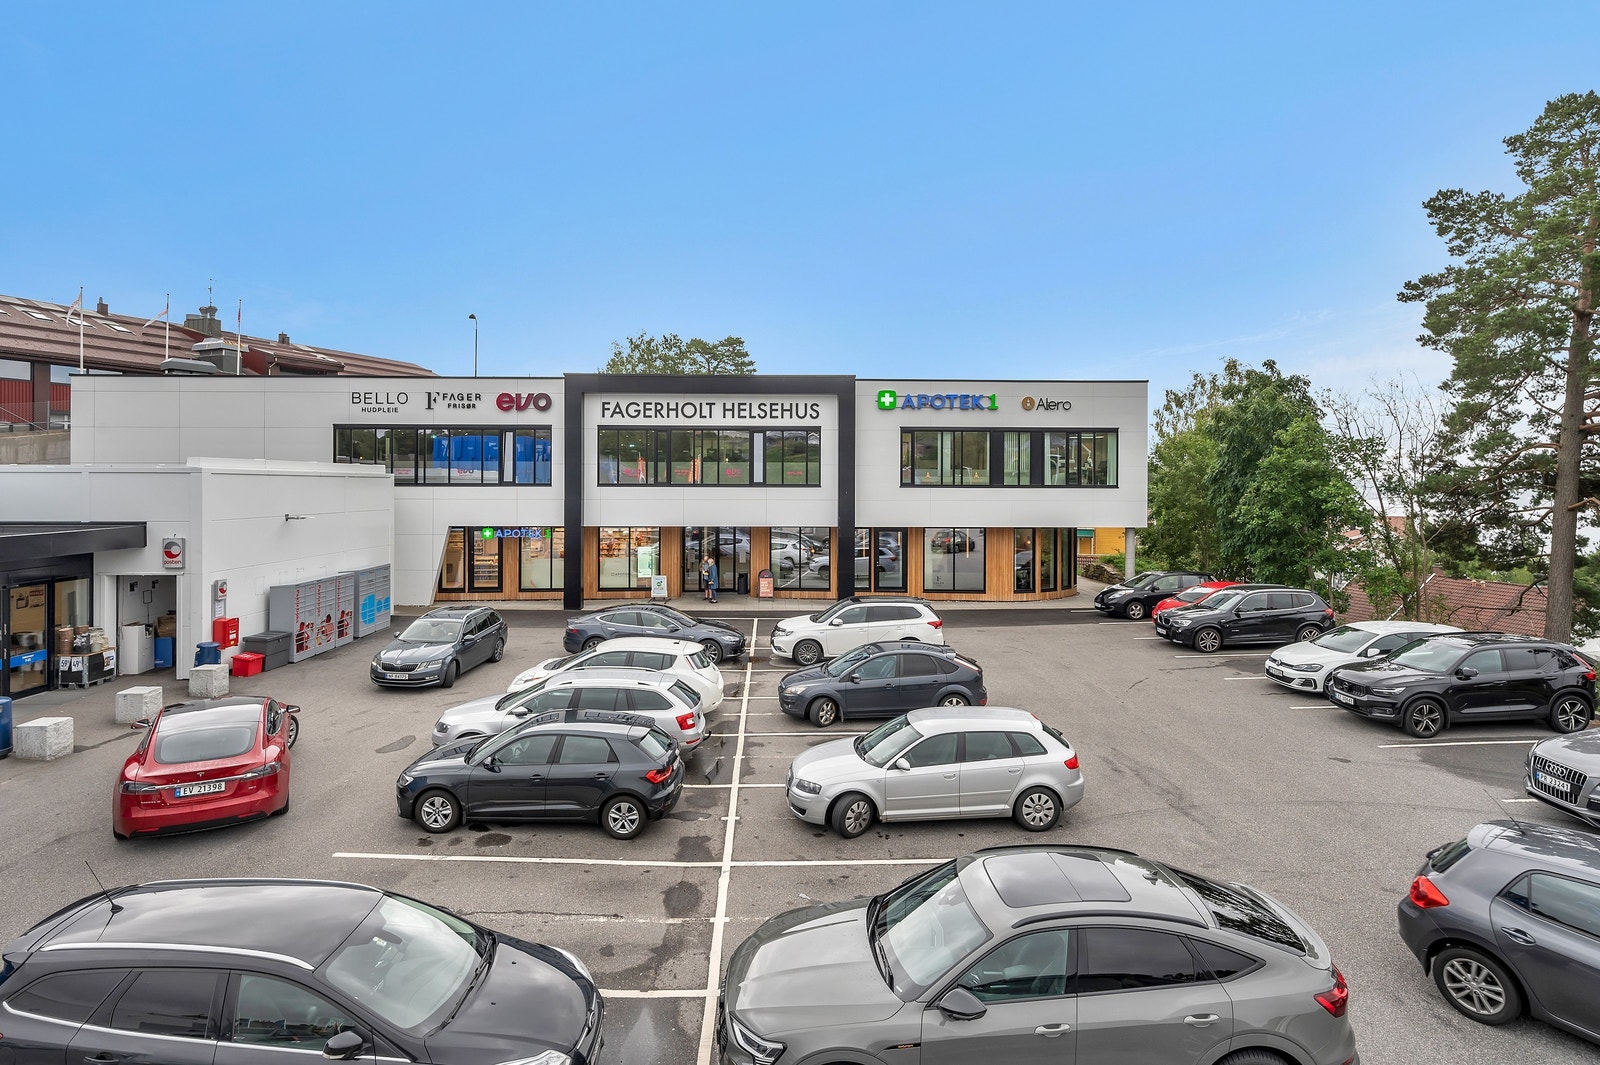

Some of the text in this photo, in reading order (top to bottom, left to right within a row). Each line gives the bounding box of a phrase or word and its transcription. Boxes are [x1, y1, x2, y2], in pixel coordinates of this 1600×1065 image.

[351, 392, 408, 404] BELLO
[442, 393, 482, 401] FAGER
[496, 392, 552, 411] evo
[601, 401, 820, 419] FAGERHOLT HELSEHUS
[1036, 397, 1072, 411] Alero
[197, 783, 222, 793] 21398
[1549, 777, 1569, 790] 23241
